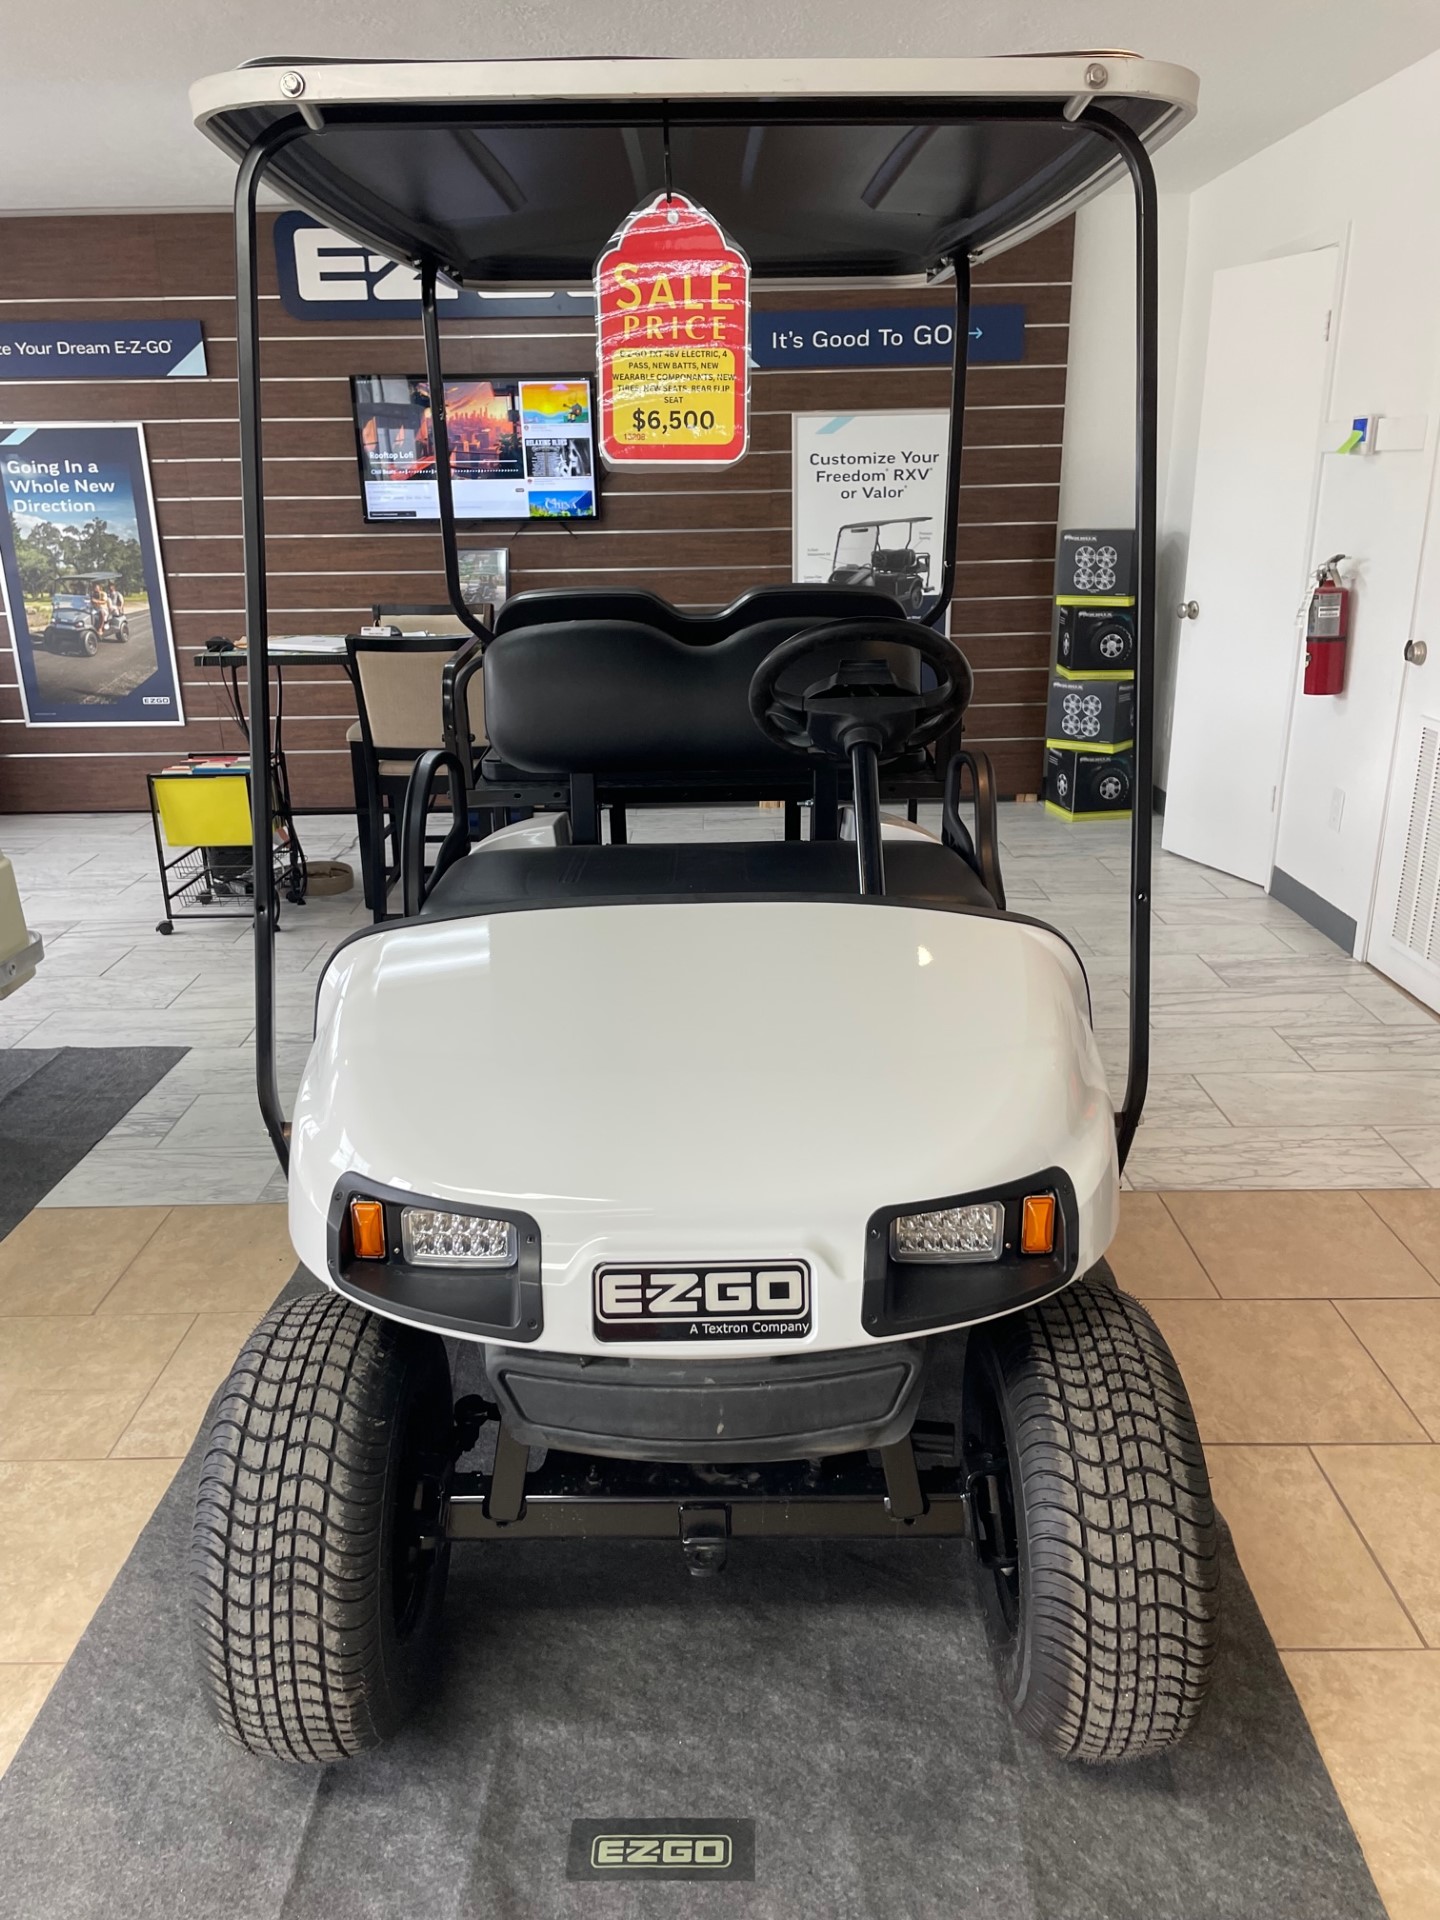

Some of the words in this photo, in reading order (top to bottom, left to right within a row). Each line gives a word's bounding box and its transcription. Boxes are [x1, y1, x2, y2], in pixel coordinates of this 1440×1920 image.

[614, 262, 735, 310] SALE
[623, 315, 727, 340] PRICE
[772, 331, 804, 349] It's
[812, 329, 870, 348] Good
[878, 328, 904, 346] To
[913, 324, 953, 345] GO
[15, 342, 52, 355] Your
[56, 341, 110, 355] Dream
[681, 350, 721, 359] ELECTRIC,
[722, 350, 728, 358] 4
[628, 362, 651, 370] PASS,
[672, 362, 699, 370] BATTS,
[612, 373, 655, 381] WEARABLE
[717, 373, 735, 381] NEW
[691, 384, 712, 392] REAR
[664, 396, 684, 404] SEAT
[632, 407, 715, 434] $6,500
[369, 451, 399, 460] Rooftop
[809, 452, 896, 465] Customize
[901, 451, 940, 463] Your
[7, 460, 60, 476] Going
[65, 460, 83, 473] In
[87, 462, 99, 473] a
[816, 470, 886, 482] Freedom
[893, 469, 930, 481] RXV
[9, 480, 70, 493] Whole
[75, 479, 115, 492] New
[840, 489, 858, 499] or
[862, 486, 904, 499] Valor
[13, 499, 96, 513] Direction
[689, 1324, 699, 1335] A
[702, 1323, 749, 1335] Textron
[752, 1322, 810, 1334] Company
